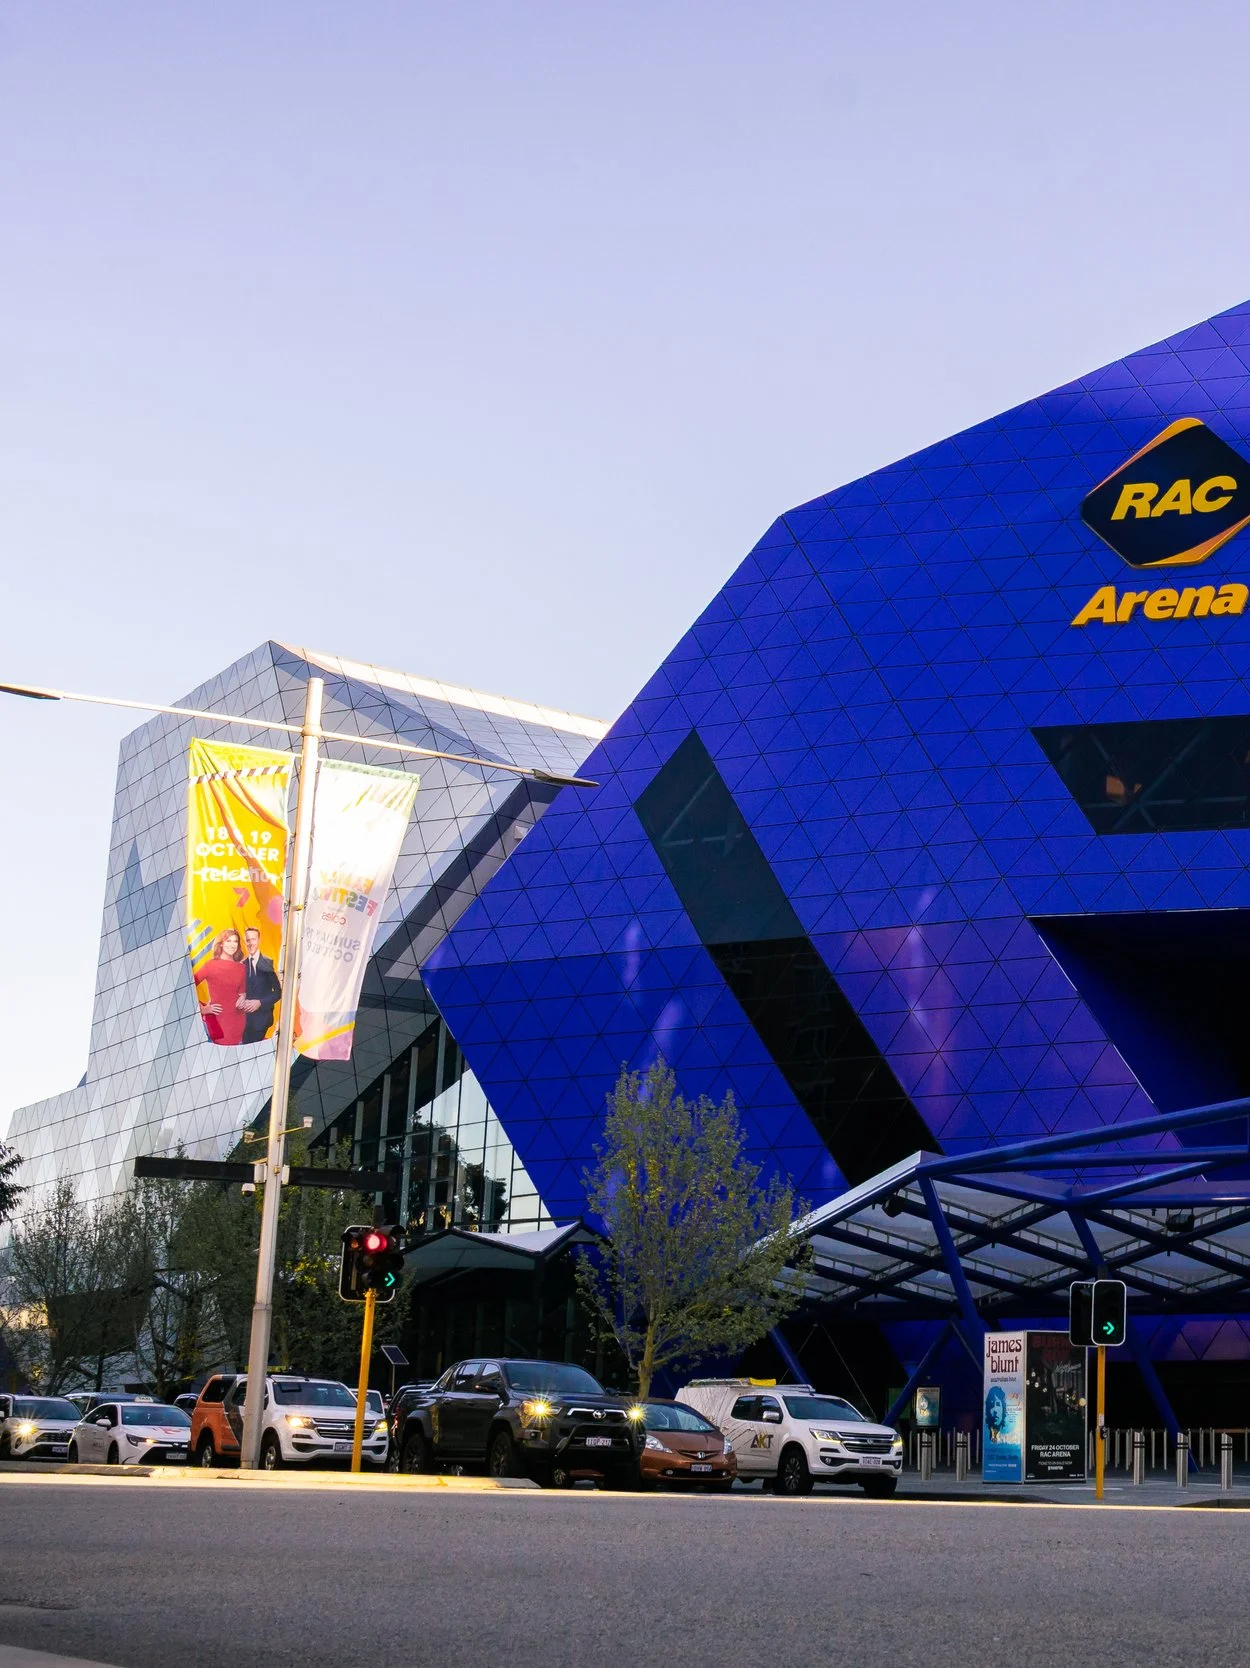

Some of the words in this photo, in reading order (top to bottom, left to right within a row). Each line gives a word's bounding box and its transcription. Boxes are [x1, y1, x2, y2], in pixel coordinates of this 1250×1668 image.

[1110, 475, 1238, 521] RAC
[1071, 583, 1249, 627] Arena
[207, 826, 228, 841] 18
[250, 830, 272, 845] 19
[195, 842, 280, 862] OCTOBER
[986, 1336, 1022, 1358] james
[991, 1356, 1019, 1373] blunt
[750, 1434, 774, 1449] AKT
